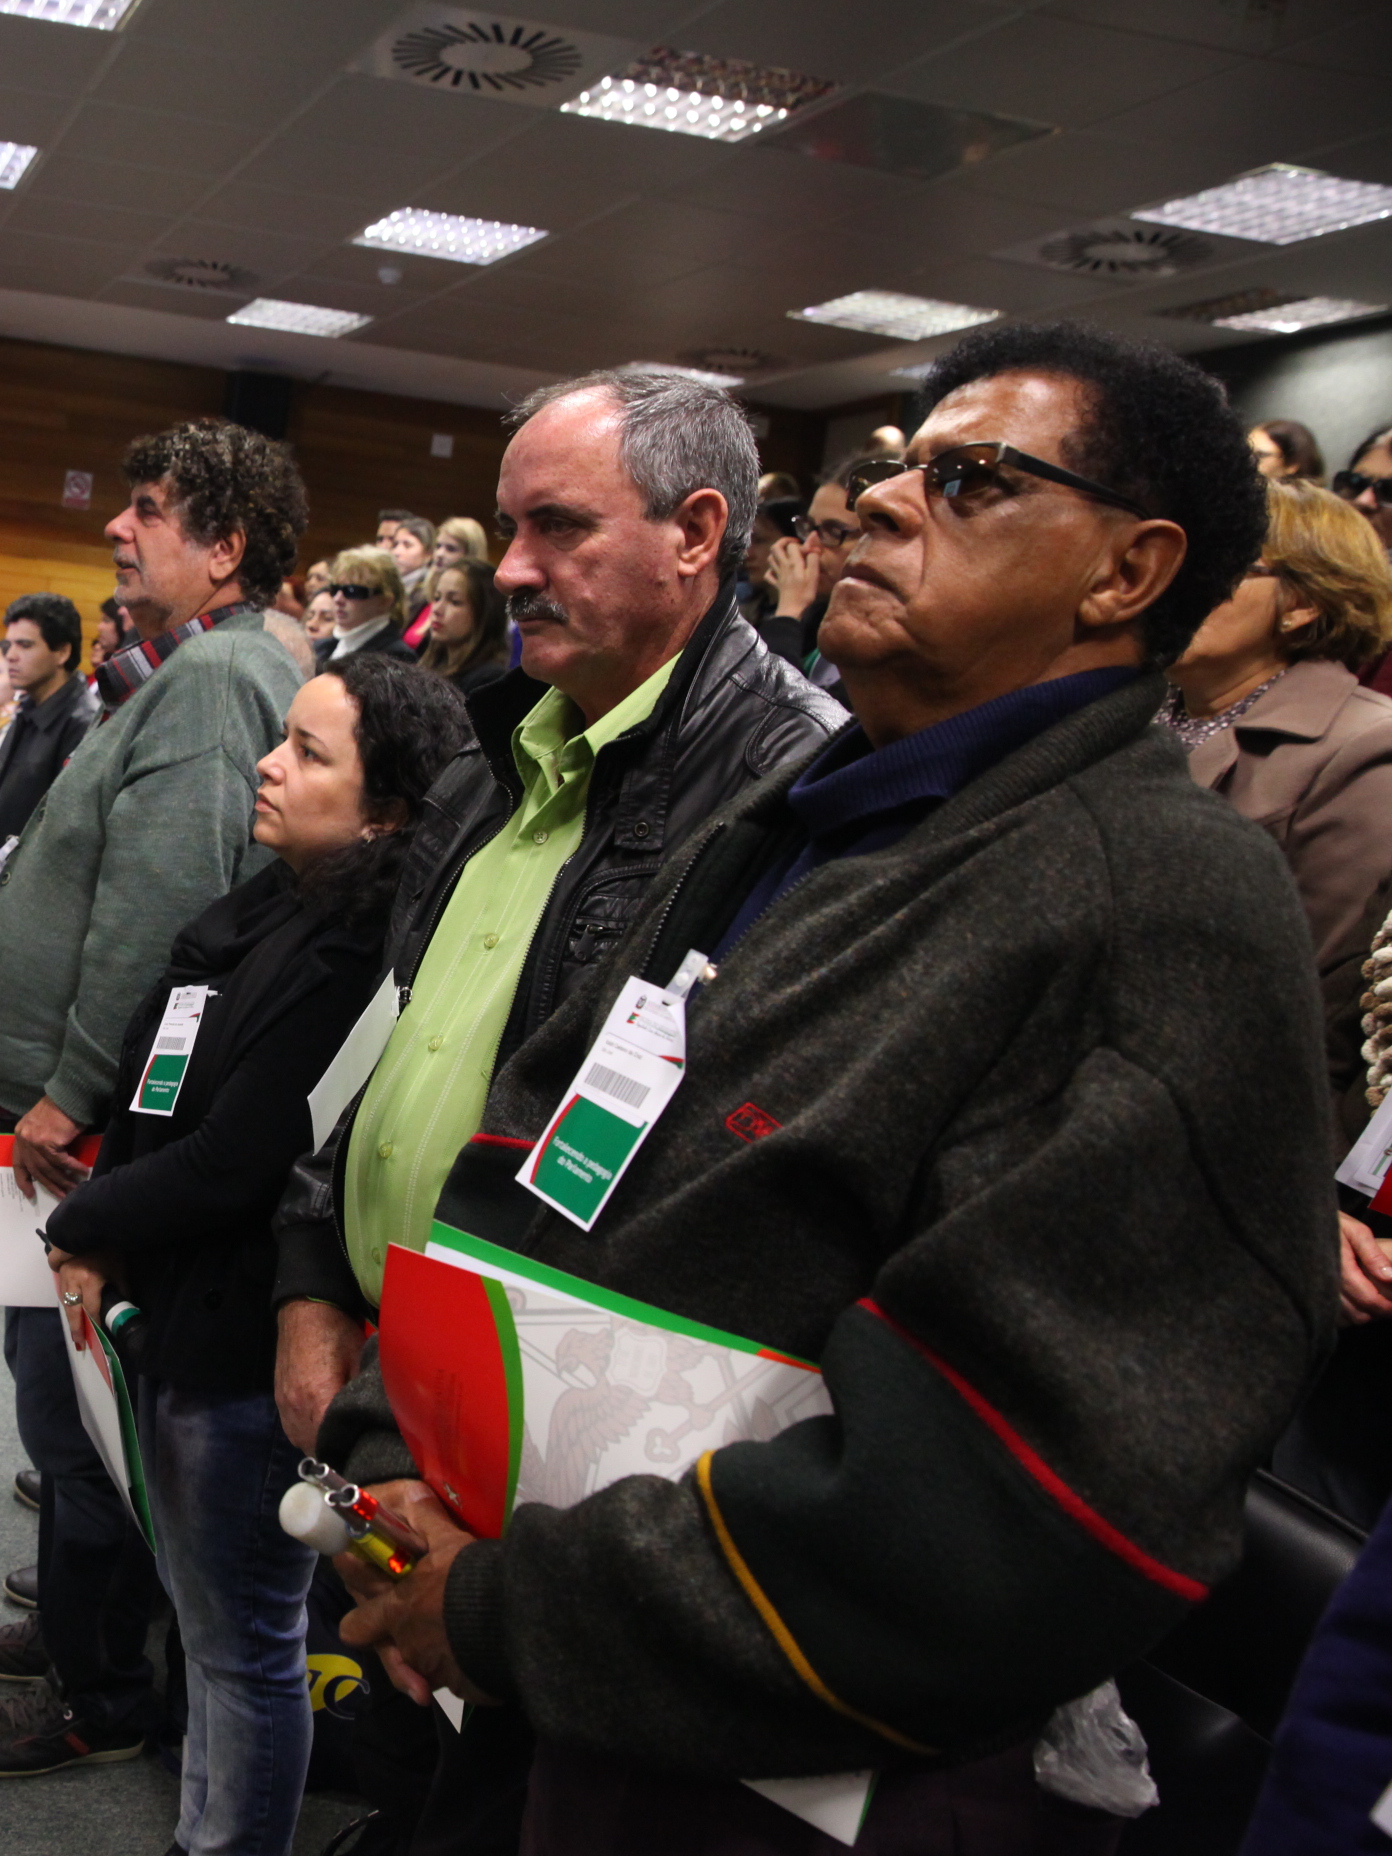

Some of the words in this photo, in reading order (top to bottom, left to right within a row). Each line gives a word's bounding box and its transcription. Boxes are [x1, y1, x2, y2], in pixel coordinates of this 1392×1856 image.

[552, 1136, 585, 1162] Fortalecendo
[585, 1159, 613, 1180] pedagogia
[557, 1155, 566, 1167] do
[564, 1159, 593, 1183] Parlamento
